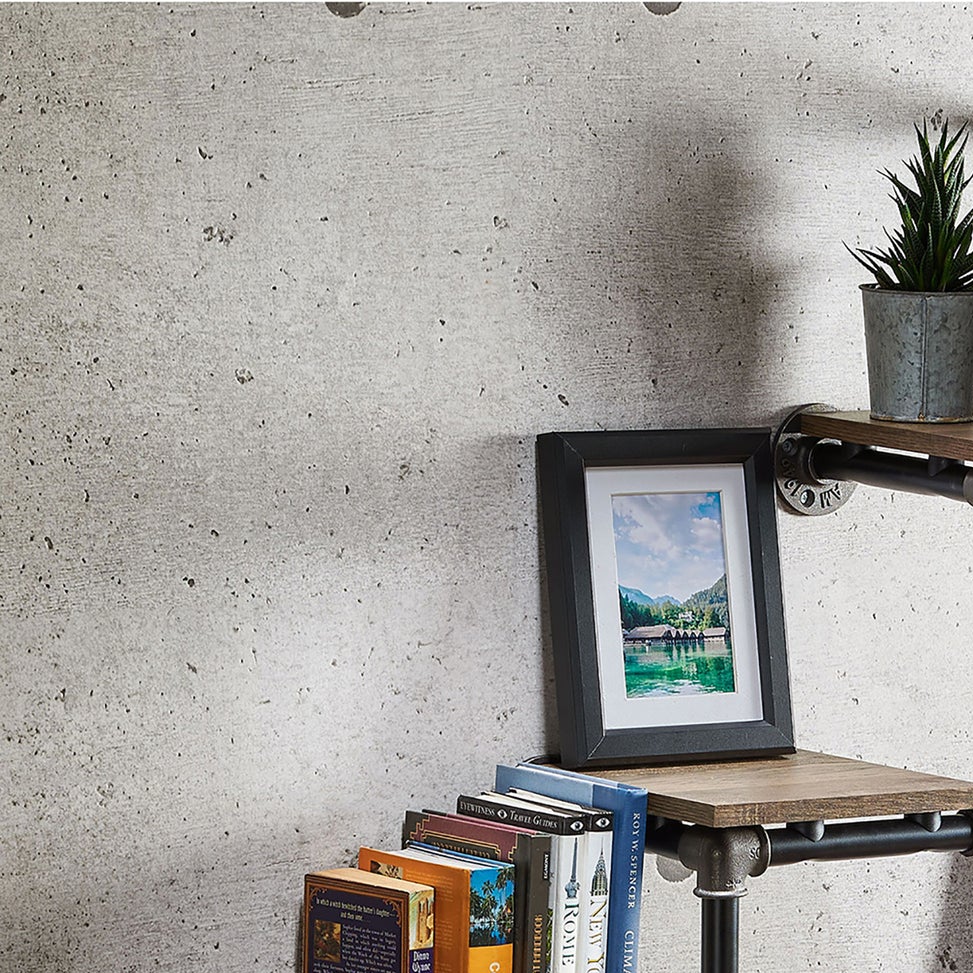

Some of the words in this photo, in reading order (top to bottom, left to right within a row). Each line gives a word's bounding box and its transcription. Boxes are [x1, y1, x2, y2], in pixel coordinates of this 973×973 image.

[460, 800, 496, 817] EYEWITNESS
[509, 809, 532, 825] TRAVEL
[533, 815, 558, 828] GUIDES
[632, 812, 640, 838] ROY
[627, 854, 638, 909] SPENCER
[561, 903, 579, 966] ROME
[588, 899, 608, 946] NEW
